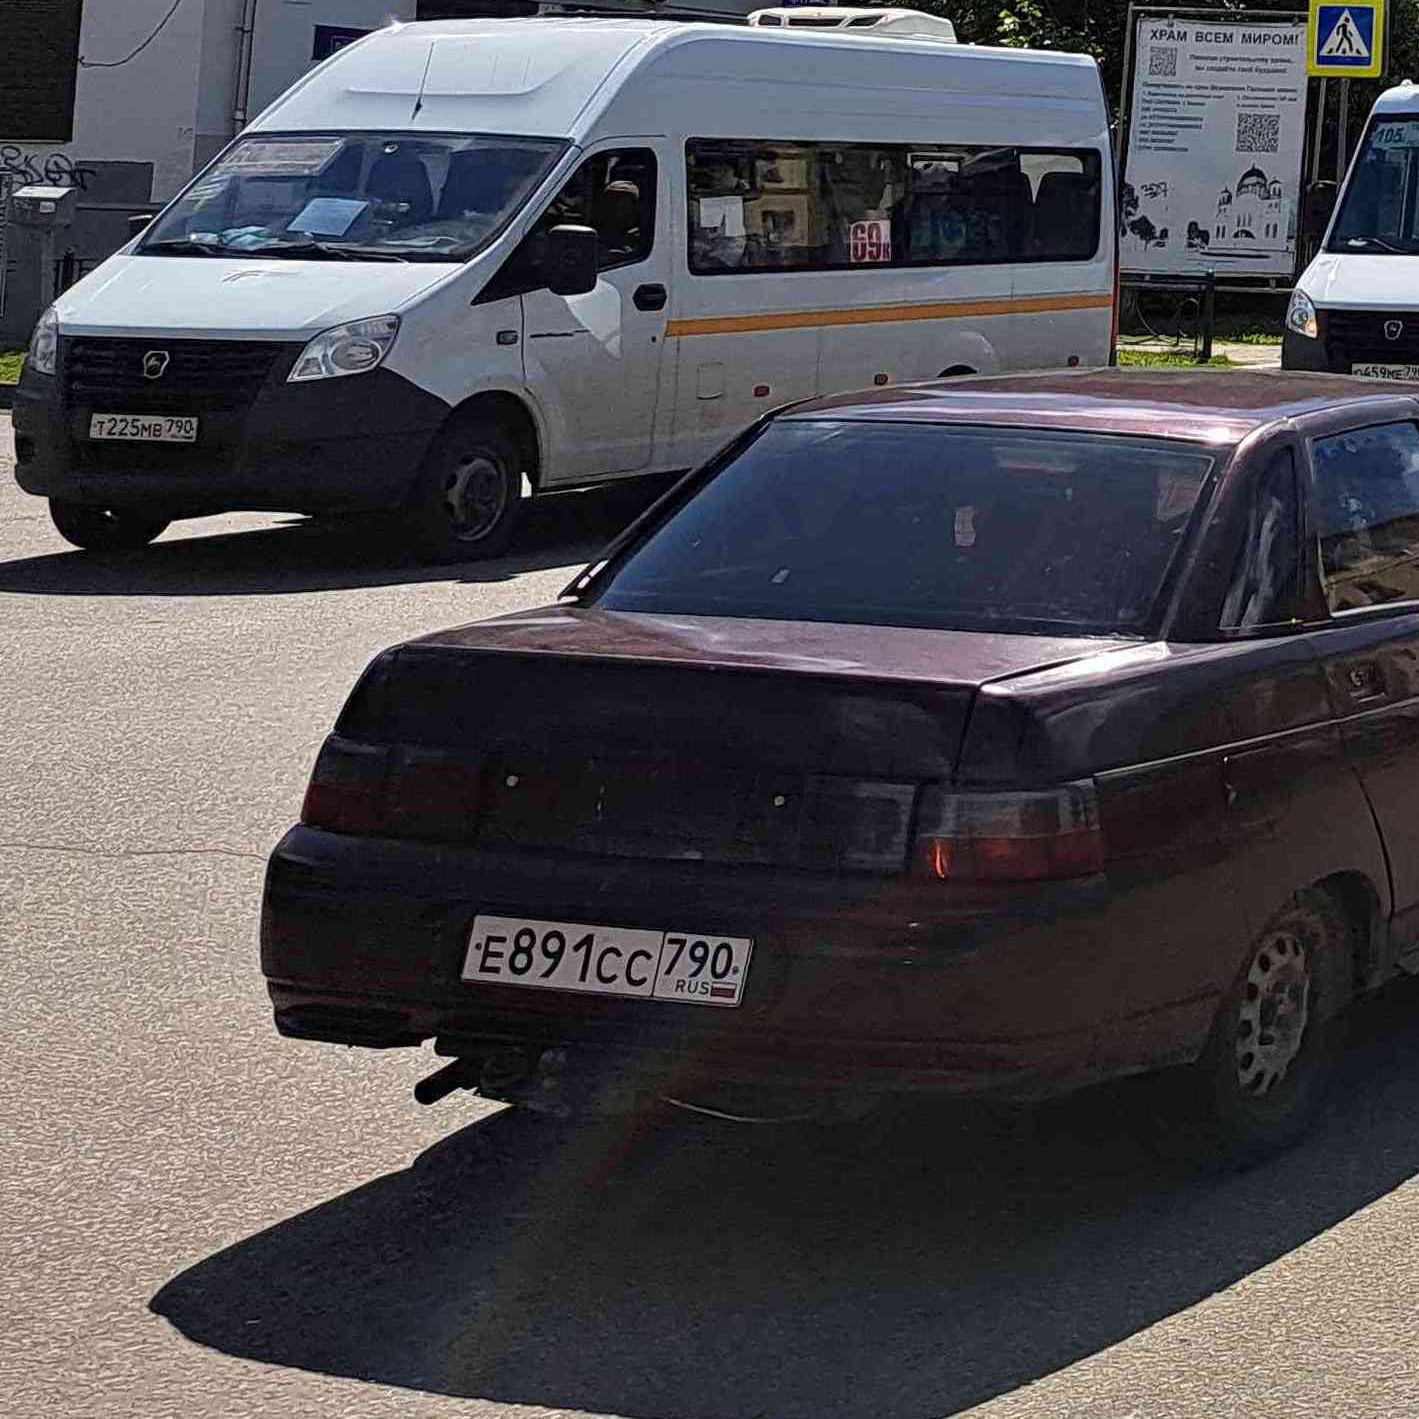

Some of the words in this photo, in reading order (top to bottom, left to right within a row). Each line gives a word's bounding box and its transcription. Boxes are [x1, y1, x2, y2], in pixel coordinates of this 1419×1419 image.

[1150, 29, 1188, 42] ХРАМ
[1195, 31, 1234, 44] ВСЕМ
[1241, 33, 1299, 46] МИРОМ!
[664, 937, 734, 980] 790
[675, 980, 710, 995] RUS
